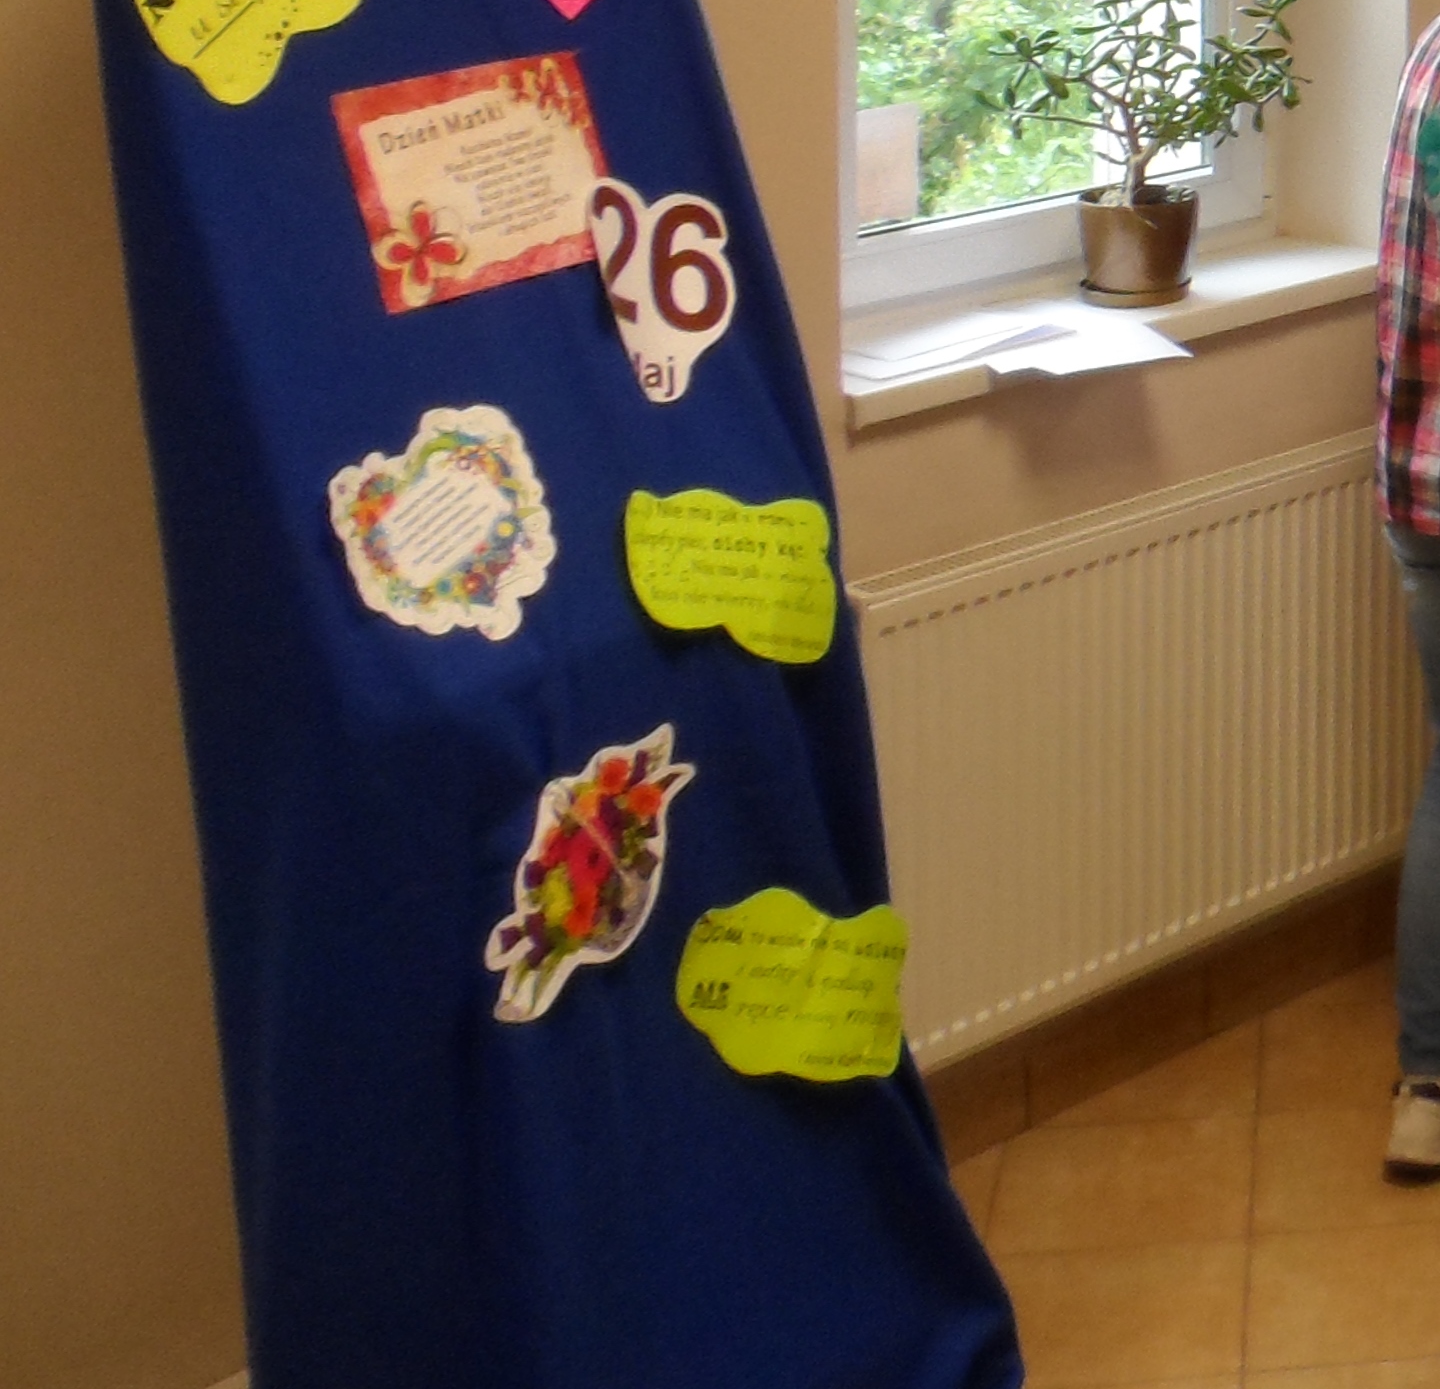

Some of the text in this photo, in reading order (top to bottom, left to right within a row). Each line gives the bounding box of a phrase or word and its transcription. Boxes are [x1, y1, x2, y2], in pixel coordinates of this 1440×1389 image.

[377, 118, 440, 156] Dzień
[442, 100, 506, 135] Matki
[592, 185, 728, 333] 26
